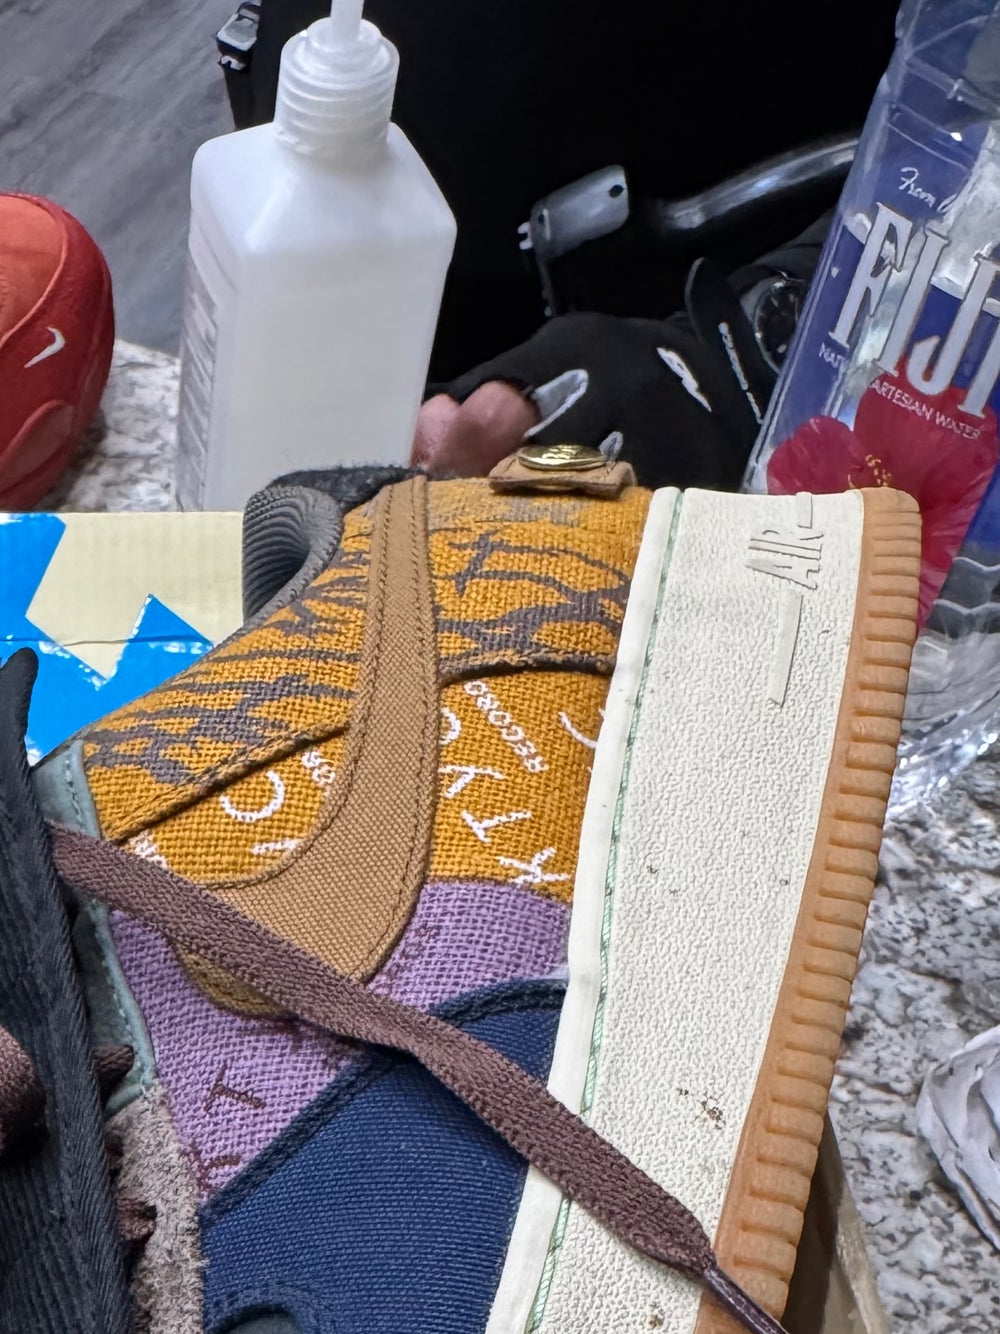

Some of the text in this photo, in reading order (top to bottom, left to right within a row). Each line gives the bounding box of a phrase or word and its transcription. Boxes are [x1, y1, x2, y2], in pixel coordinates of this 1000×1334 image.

[828, 201, 1000, 419] FIJI
[868, 378, 982, 441] ARTESIAN WATER
[745, 528, 825, 591] AIR
